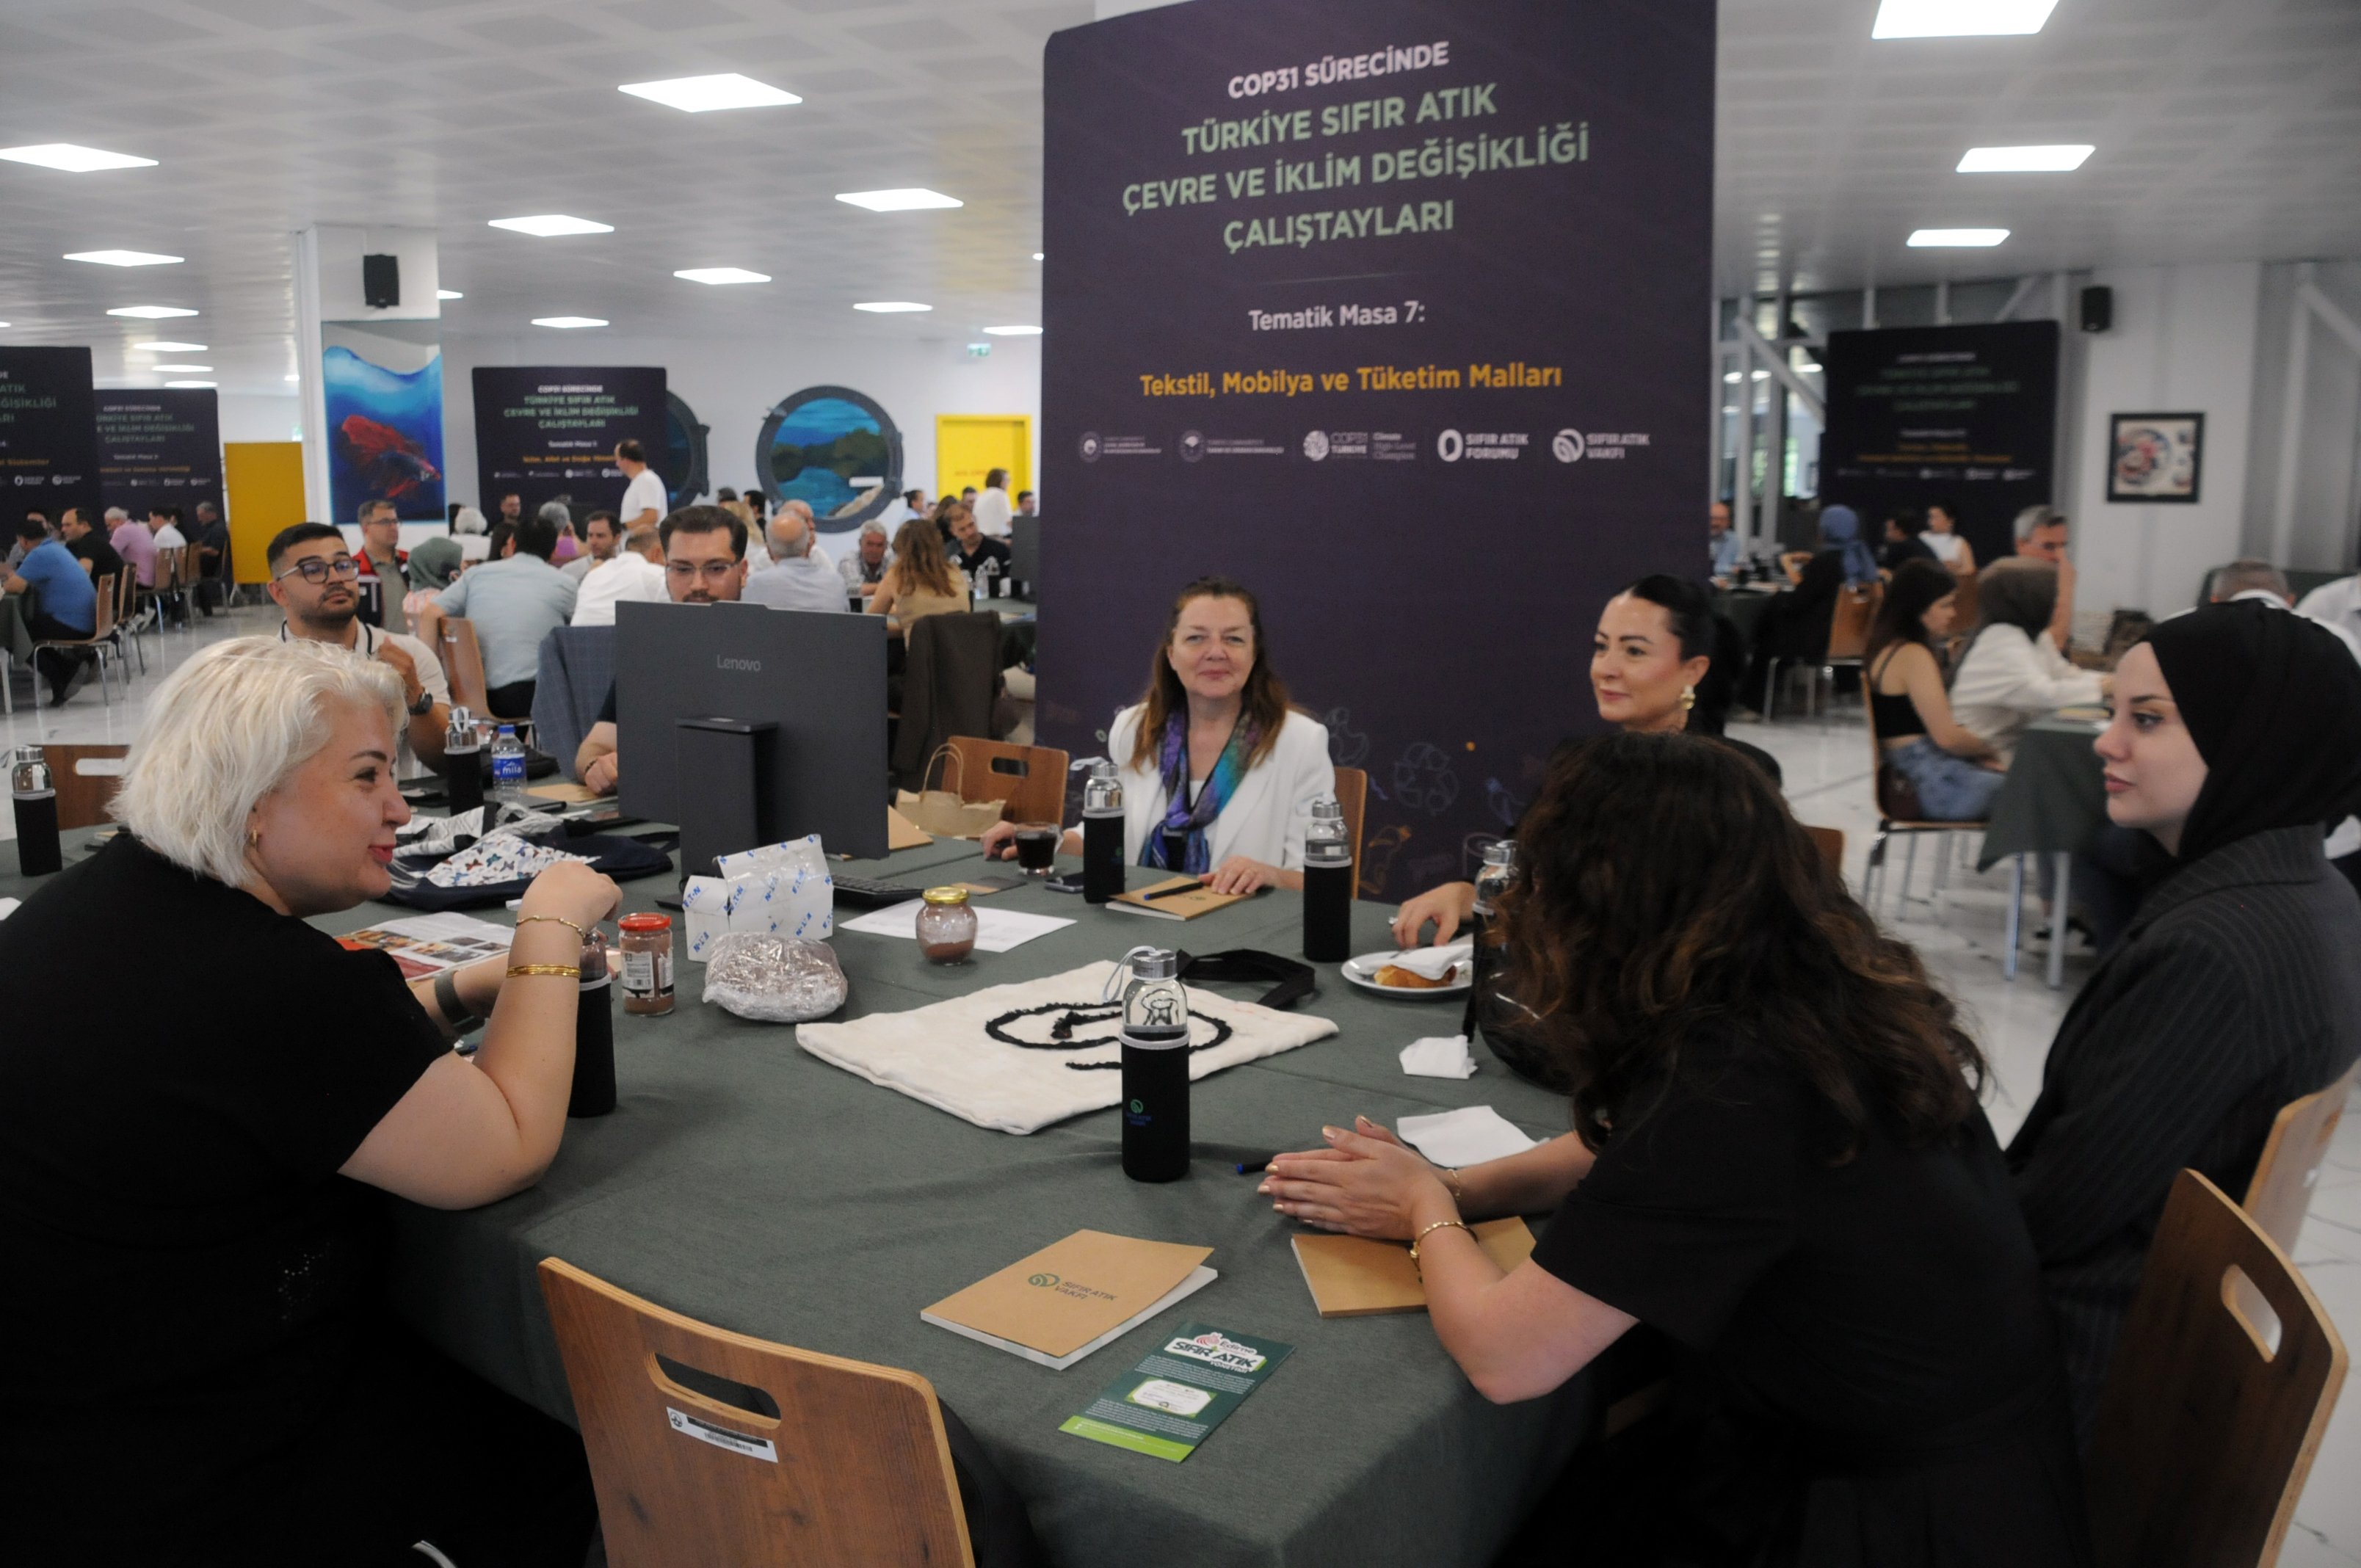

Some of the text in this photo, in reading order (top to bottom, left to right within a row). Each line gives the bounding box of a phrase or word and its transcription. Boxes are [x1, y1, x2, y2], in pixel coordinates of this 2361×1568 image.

[1228, 42, 1448, 98] COP31 SÜRECİNDE
[1182, 84, 1495, 154] TÜRKİYE SIFIR ATIK
[1123, 121, 1586, 215] ÇEVRE VE İKLİM DEĞİŞİKLİĞİ
[1224, 200, 1452, 254] ÇALIŞTAYLARI
[1249, 300, 1424, 330] Tematik Masa 7:
[1140, 363, 1561, 397] Tekstil, Mobilya ve Tüketim Malları
[717, 654, 761, 672] Lenovo
[1055, 1285, 1088, 1299] VAKFI
[1062, 1282, 1117, 1301] SIFIR ATIK
[1172, 1341, 1258, 1368] SIFIR ATIK
[1219, 1340, 1255, 1354] Edirne
